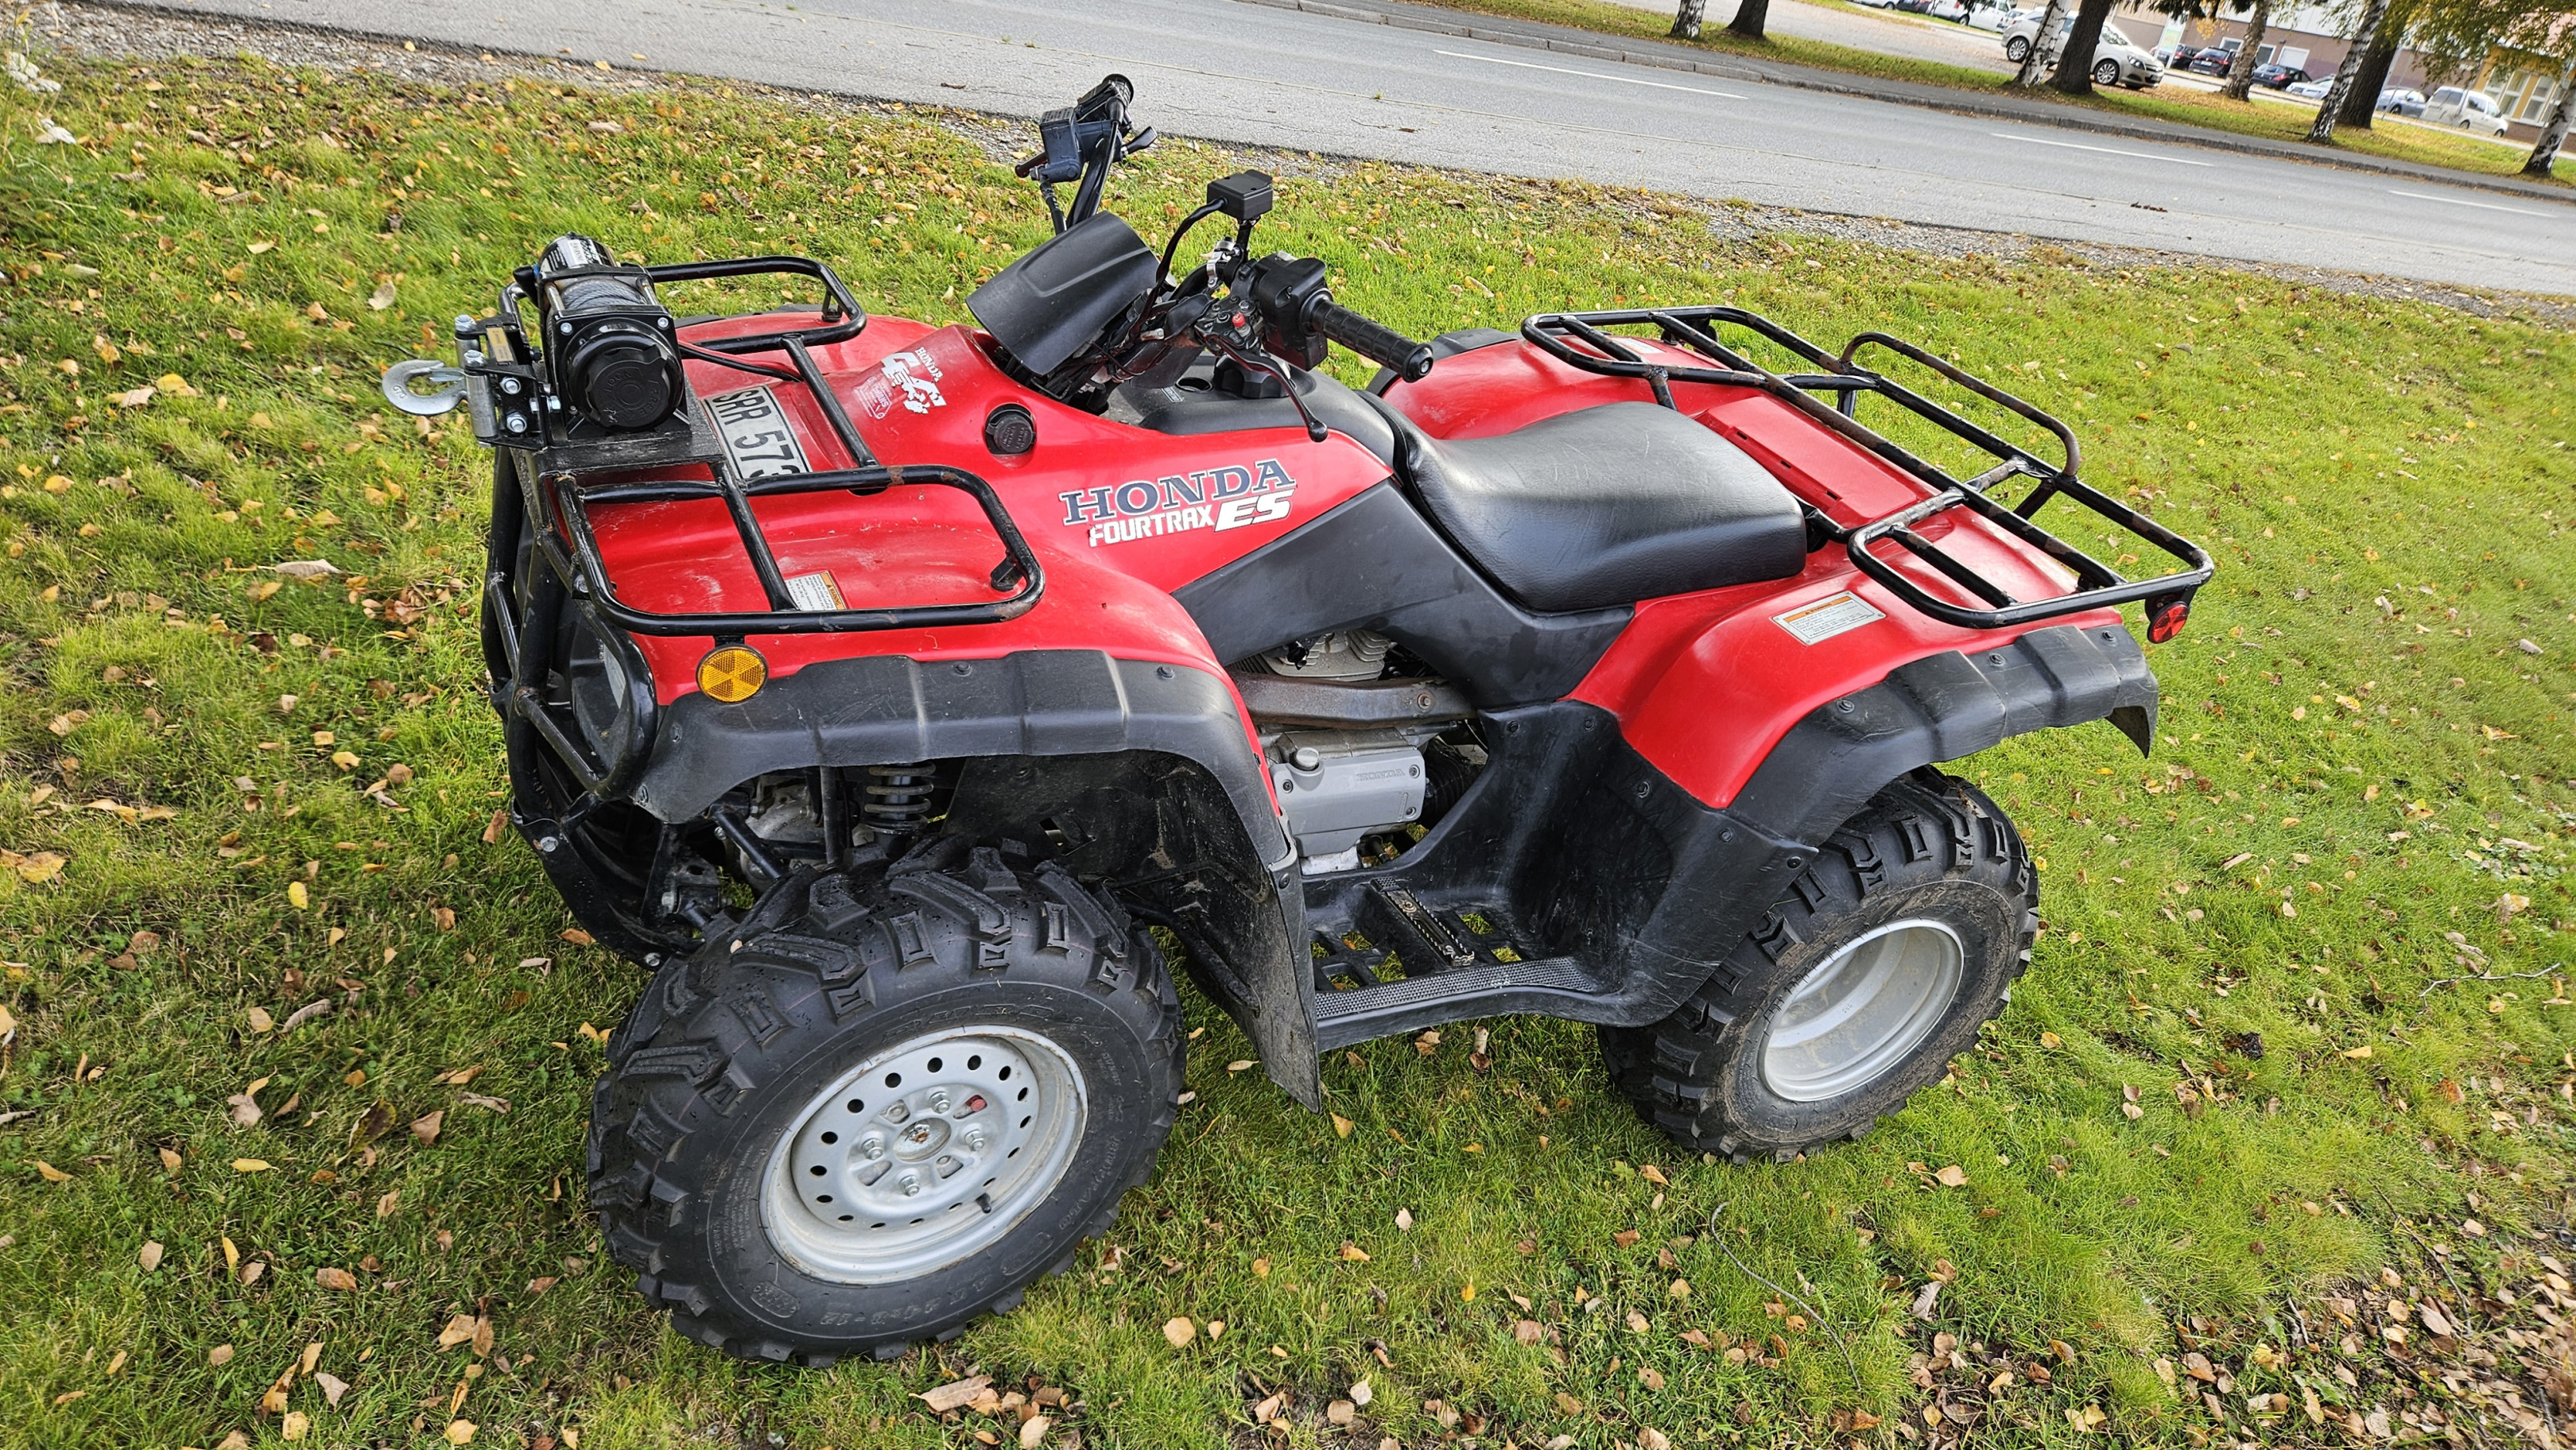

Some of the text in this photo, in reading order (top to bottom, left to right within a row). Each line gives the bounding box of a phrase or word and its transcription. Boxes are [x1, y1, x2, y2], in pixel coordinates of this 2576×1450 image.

[914, 347, 944, 382] HONDA
[712, 390, 772, 426] SRR
[1059, 458, 1296, 526] HONDA
[1088, 487, 1296, 548] FOURTRAX ES
[1356, 768, 1405, 781] HONDA
